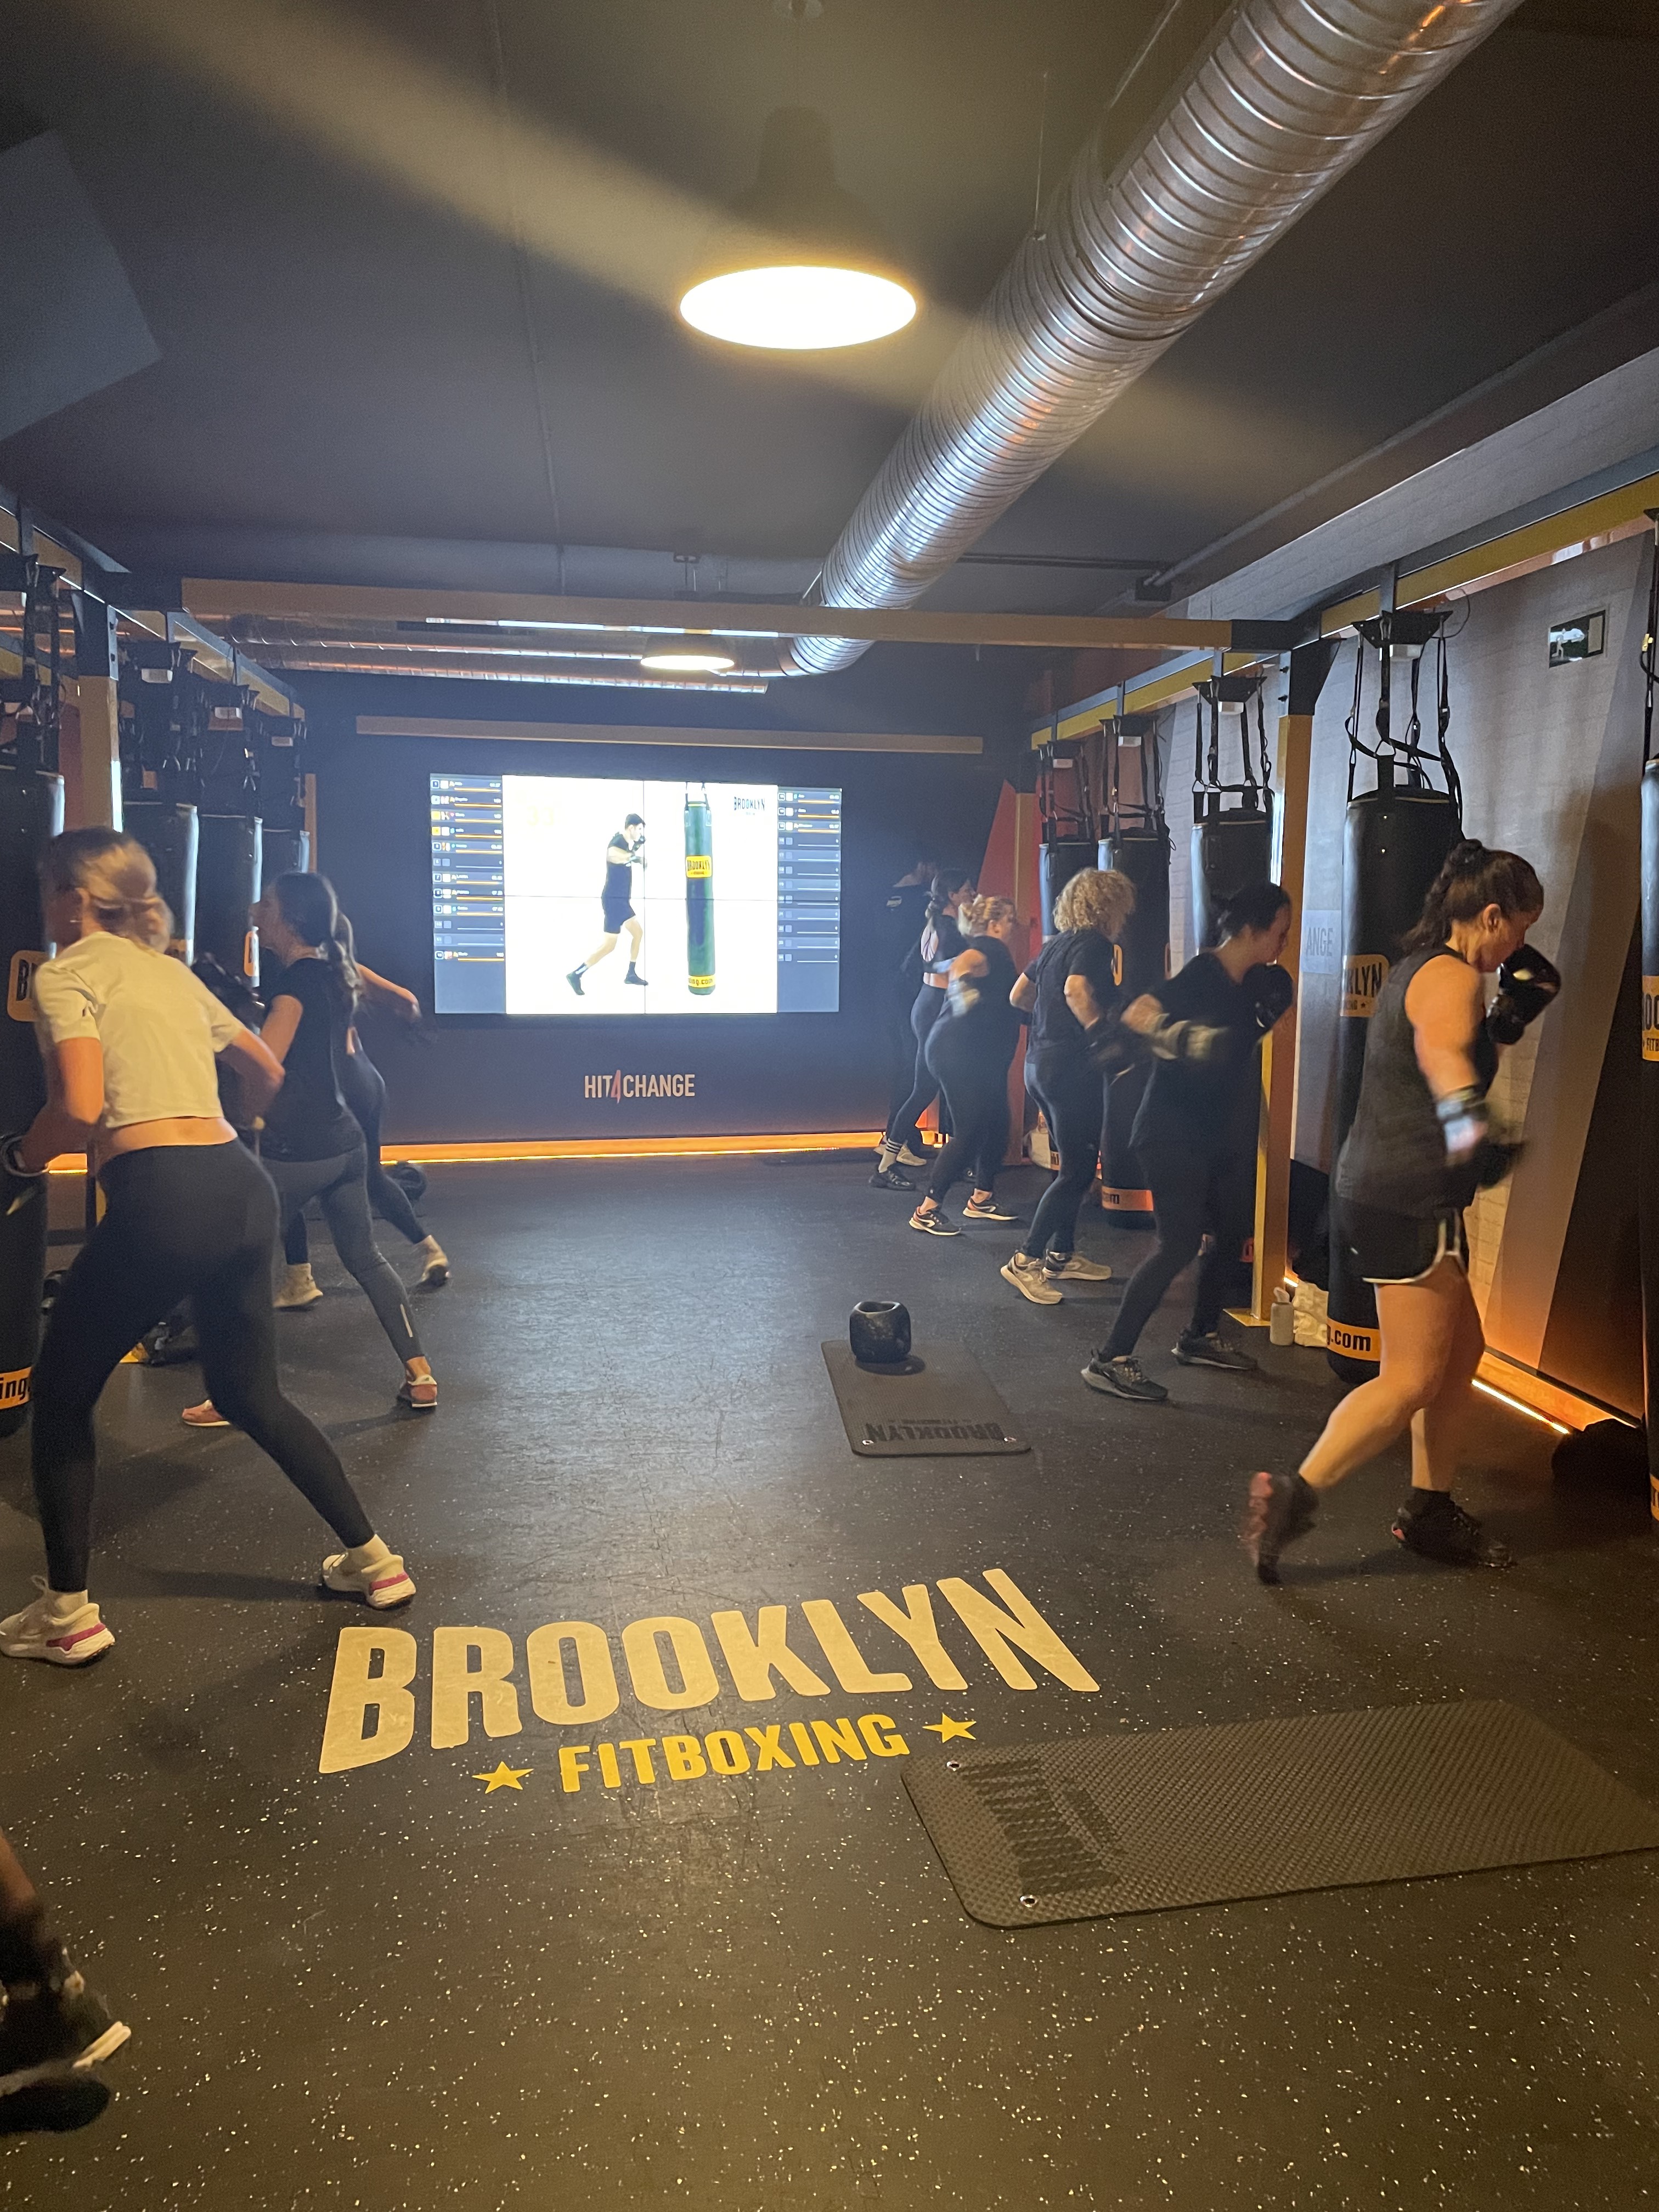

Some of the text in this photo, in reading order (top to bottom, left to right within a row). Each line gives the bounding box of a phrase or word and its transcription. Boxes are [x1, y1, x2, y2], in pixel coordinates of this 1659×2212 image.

[734, 797, 765, 811] BROOKLYN
[319, 1568, 1100, 1774] BROOKLYN
[558, 1714, 910, 1793] FITBOXING
